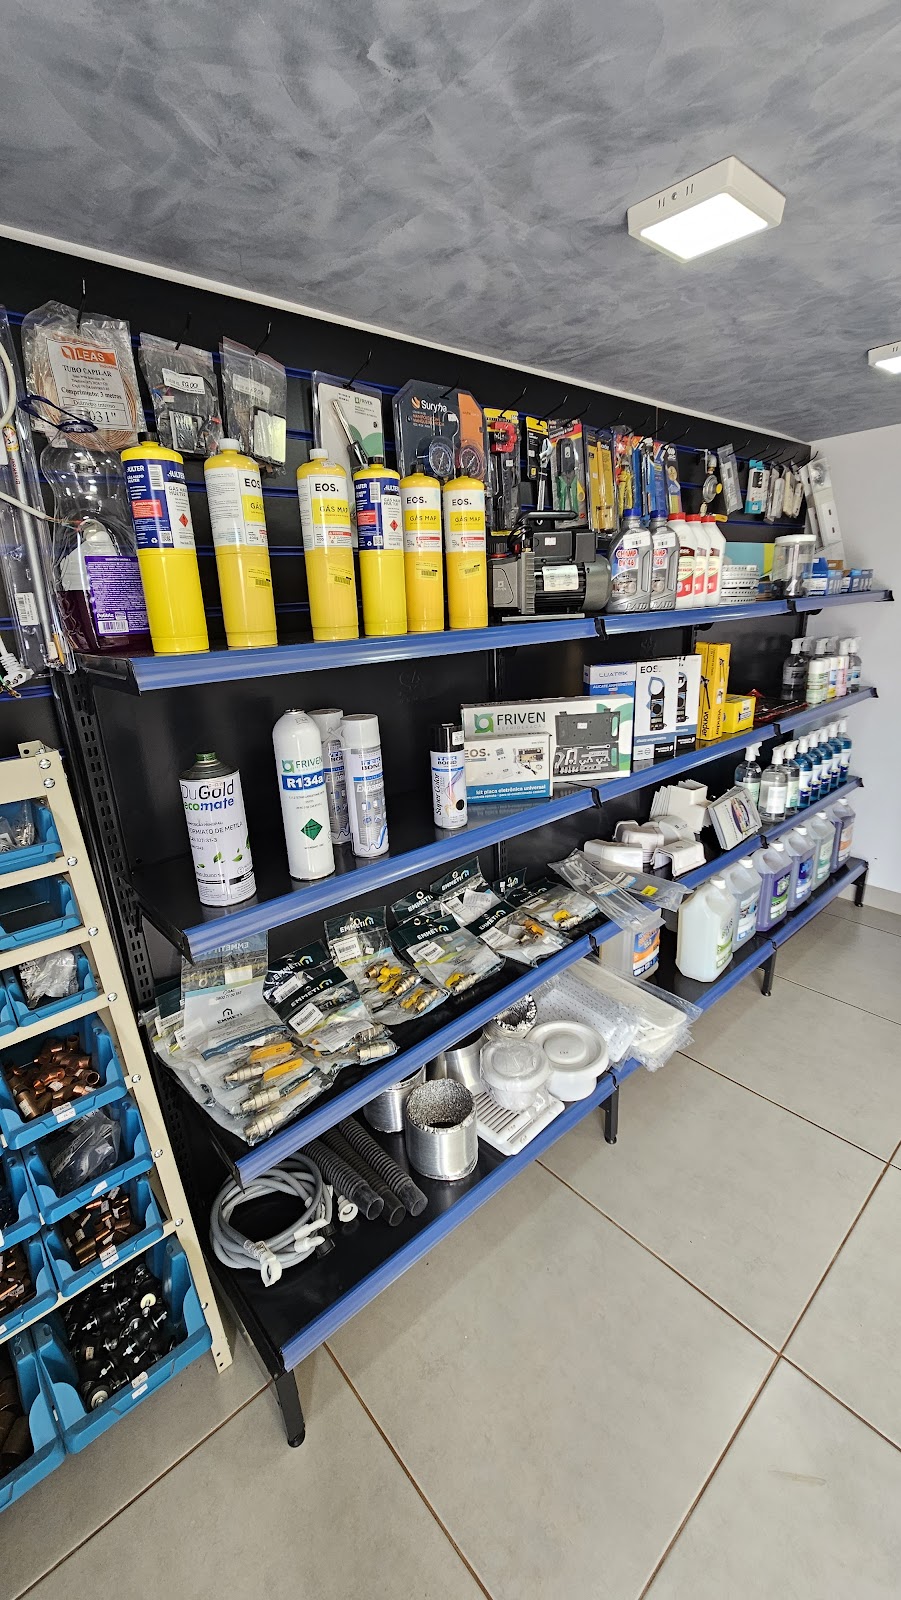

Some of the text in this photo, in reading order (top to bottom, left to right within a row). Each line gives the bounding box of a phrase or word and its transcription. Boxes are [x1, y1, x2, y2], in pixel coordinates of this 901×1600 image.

[421, 399, 447, 413] Suryha
[452, 498, 472, 506] EOS.
[497, 711, 546, 725] FRIVEN
[286, 774, 324, 789] R134a
[181, 779, 234, 800] DuGold
[435, 793, 443, 815] Super
[290, 986, 320, 1007] EMMETI
